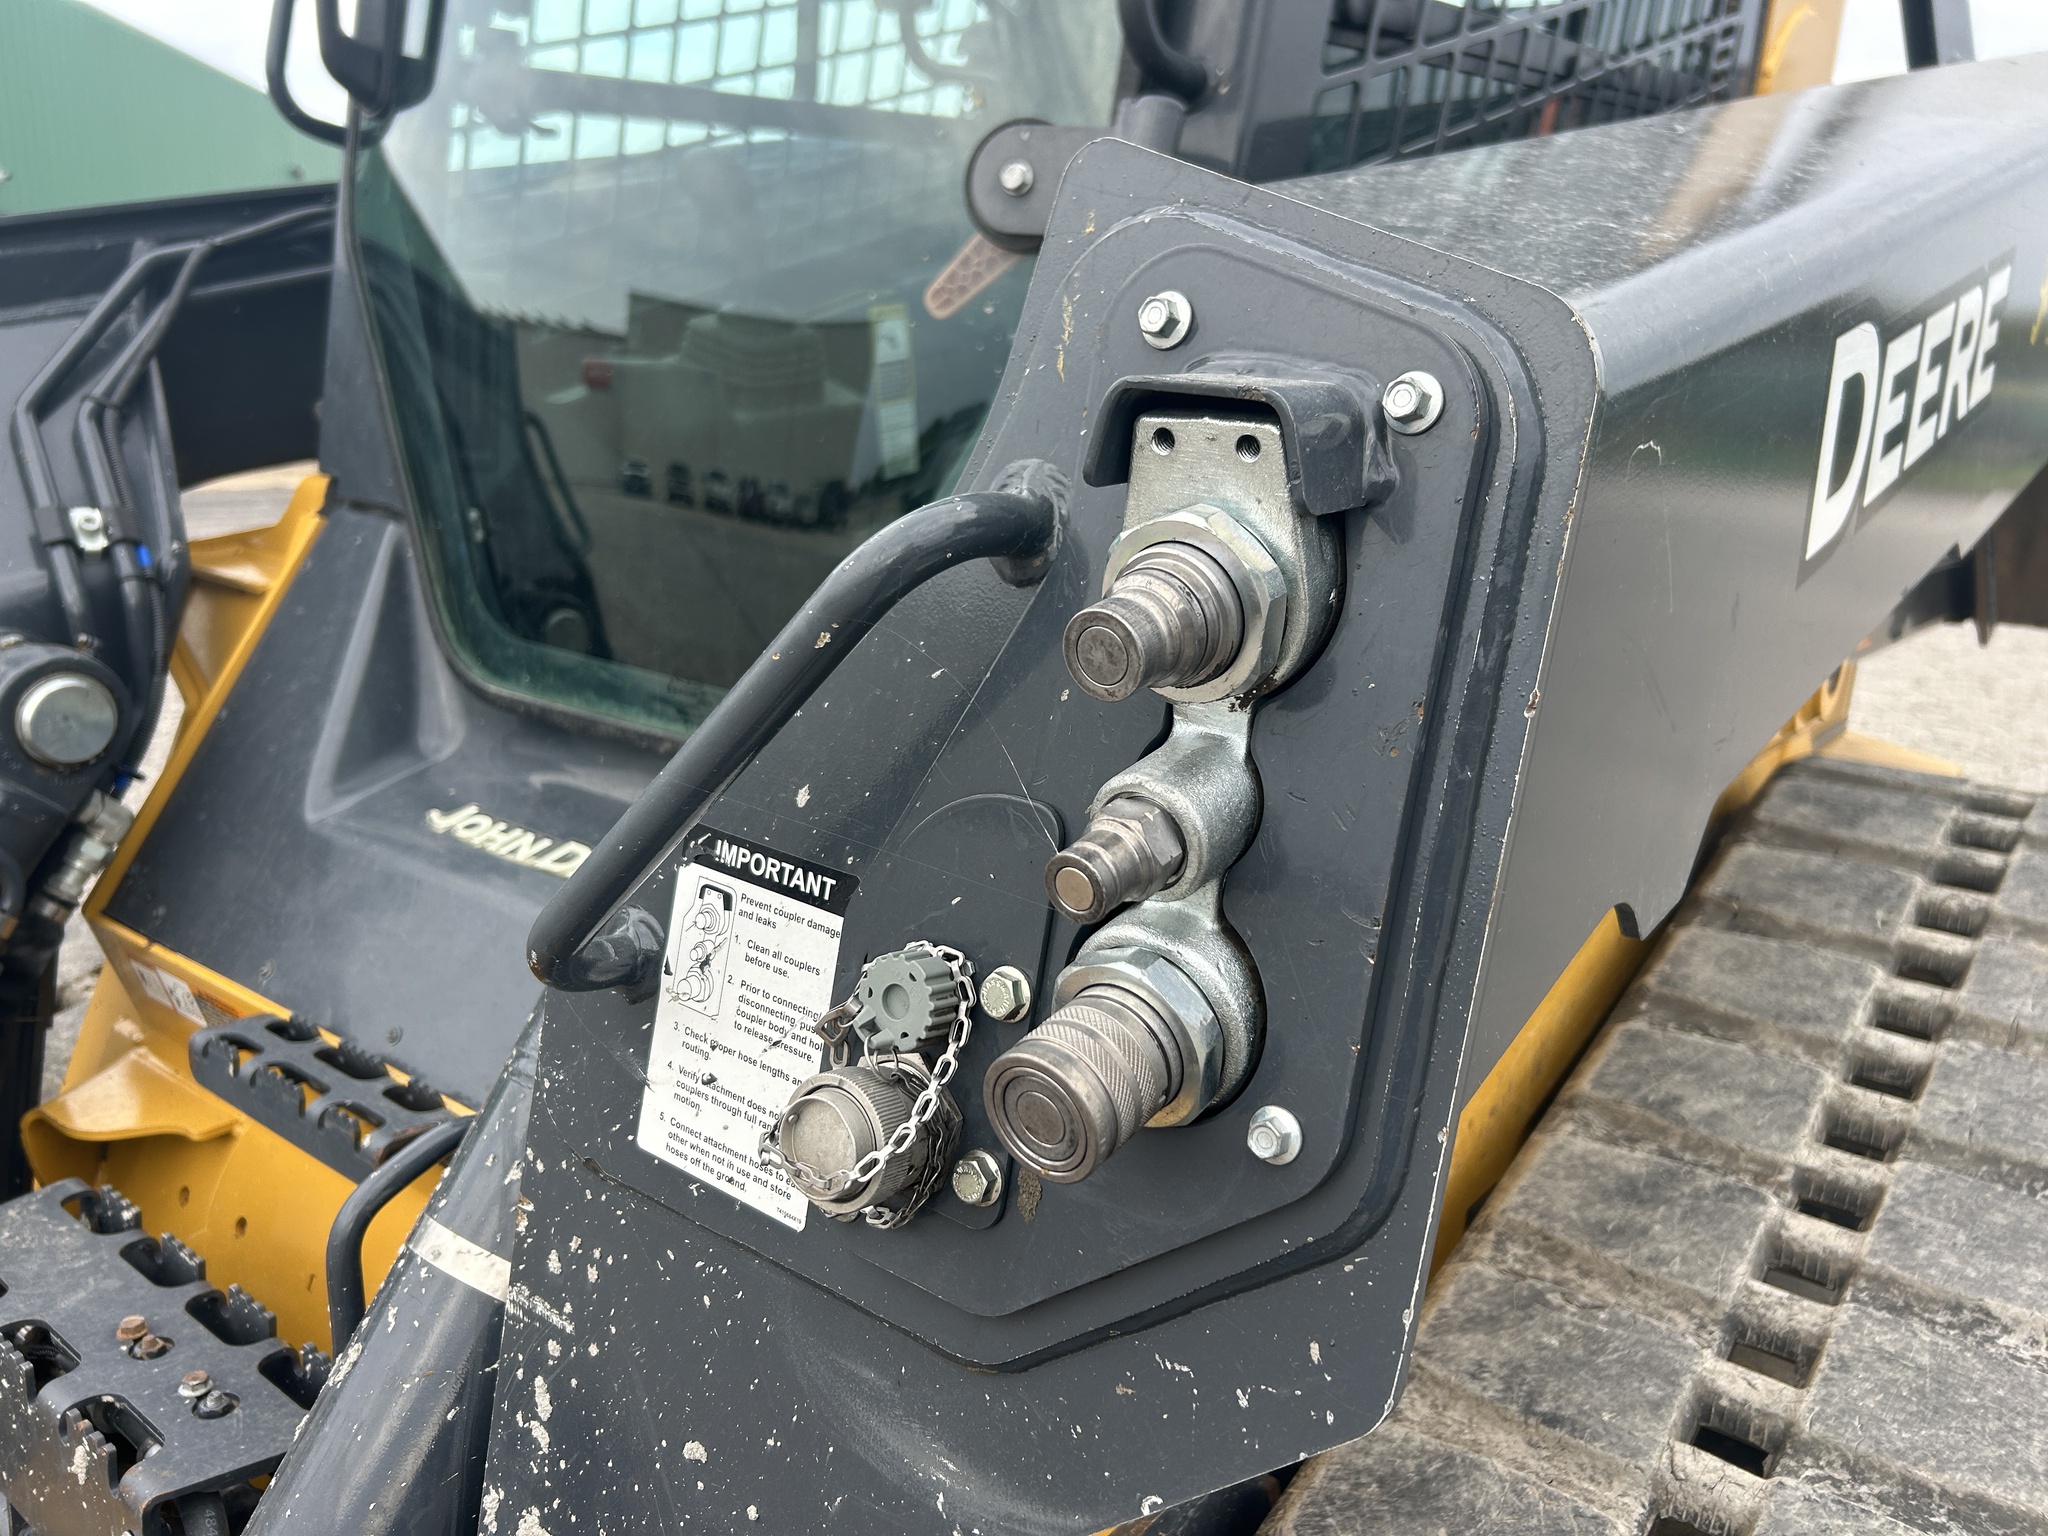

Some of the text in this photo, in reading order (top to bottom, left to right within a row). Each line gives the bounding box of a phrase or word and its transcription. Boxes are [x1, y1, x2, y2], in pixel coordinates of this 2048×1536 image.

[1806, 263, 2011, 561] DEERE
[426, 802, 553, 861] JOHN
[715, 839, 837, 901] IMPORTANT
[738, 909, 777, 929] and leaks
[741, 893, 841, 939] Prevent coupler damage
[735, 935, 821, 976] 1. Clean all couplers
[744, 953, 790, 979] before use.
[727, 974, 734, 985] 2.
[740, 980, 761, 996] Prior
[762, 988, 771, 1000] to
[733, 1020, 814, 1064] to release ressure.
[736, 1008, 767, 1027] coupler
[768, 1020, 789, 1039] body
[791, 1031, 808, 1045] and
[799, 1021, 817, 1035] pus
[673, 1022, 680, 1032] 3.
[684, 1026, 709, 1045] Check
[738, 1050, 758, 1067] hose
[759, 1060, 790, 1082] lengths
[792, 1076, 803, 1087] an
[681, 1040, 711, 1061] routing.
[667, 1060, 780, 1121] 4. Verify achment does no
[673, 1092, 702, 1112] motion.
[676, 1079, 773, 1132] couplers through full ran
[659, 1111, 666, 1122] 5.
[670, 1117, 702, 1140] Connect
[703, 1135, 748, 1164] attachment
[749, 1156, 773, 1177] hoses
[775, 1171, 784, 1182] to
[665, 1142, 689, 1161] hoses
[690, 1153, 702, 1167] off
[702, 1161, 715, 1175] the
[668, 1131, 792, 1200] other when not in use and store
